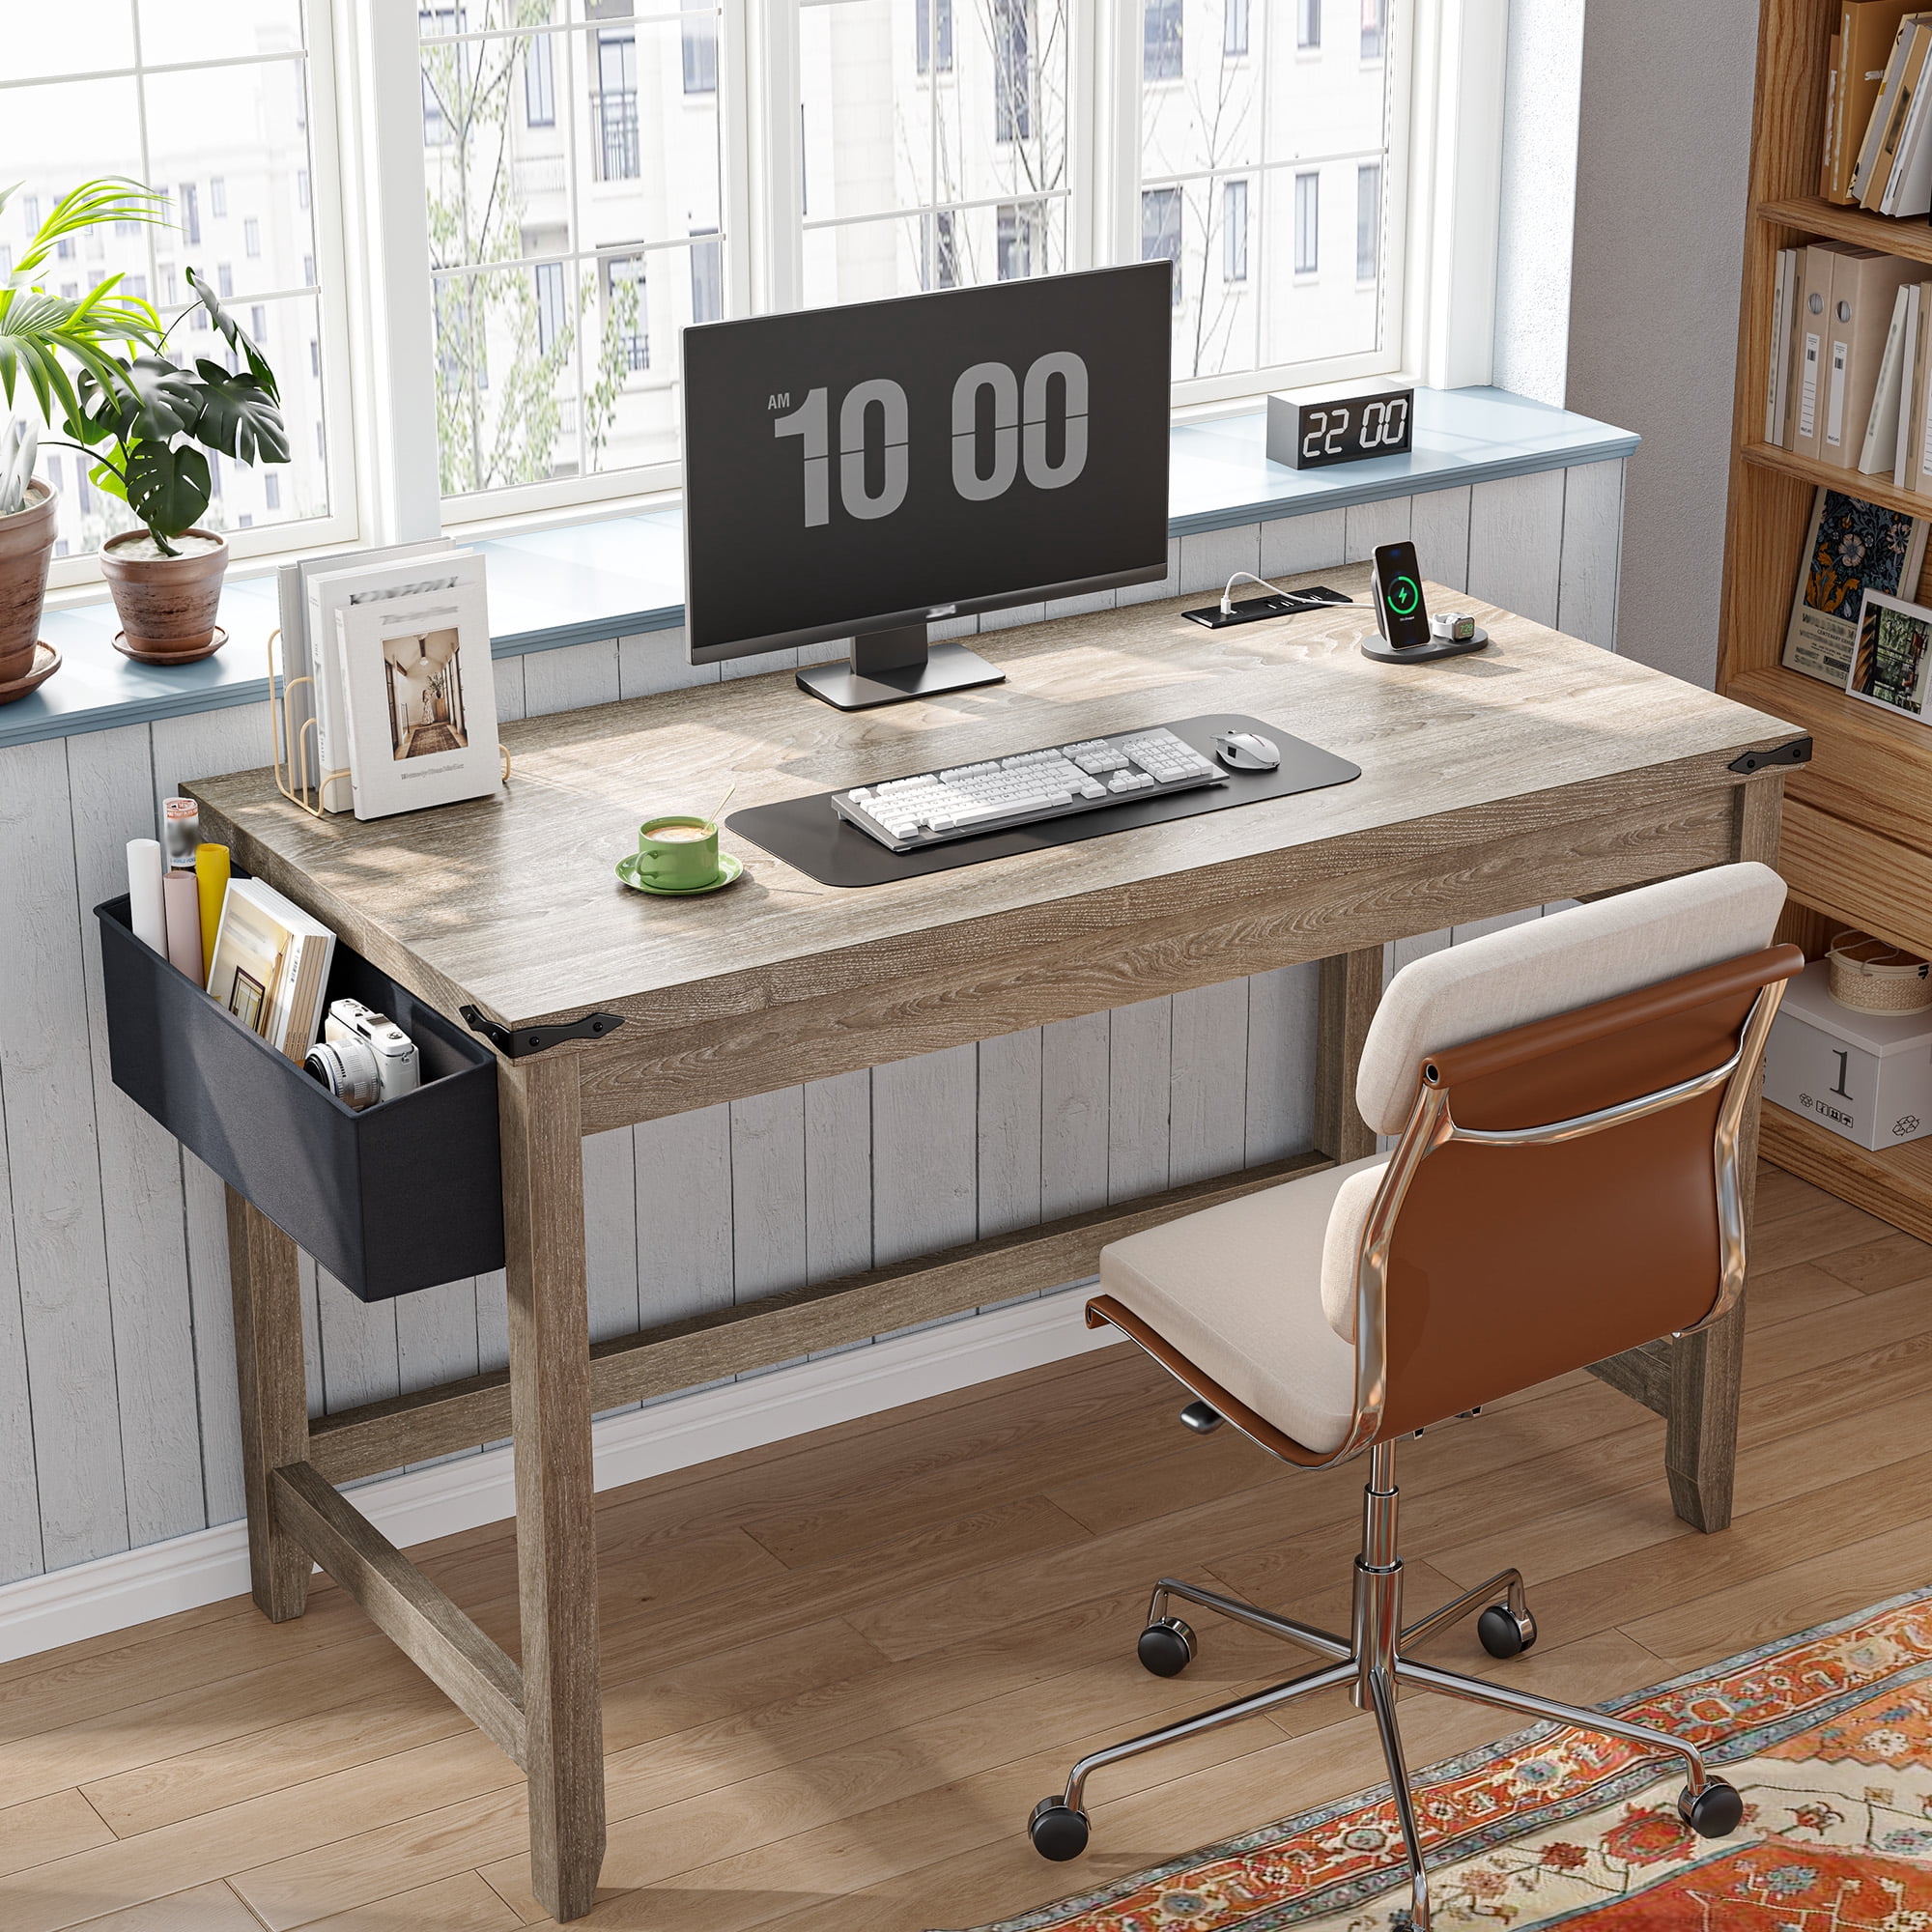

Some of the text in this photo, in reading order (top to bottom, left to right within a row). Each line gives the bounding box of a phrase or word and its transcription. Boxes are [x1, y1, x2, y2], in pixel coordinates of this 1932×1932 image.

[767, 392, 790, 411] AM
[1302, 398, 1408, 458] 22 00
[774, 351, 1089, 528] 10 00
[1830, 1049, 1854, 1101] 1
